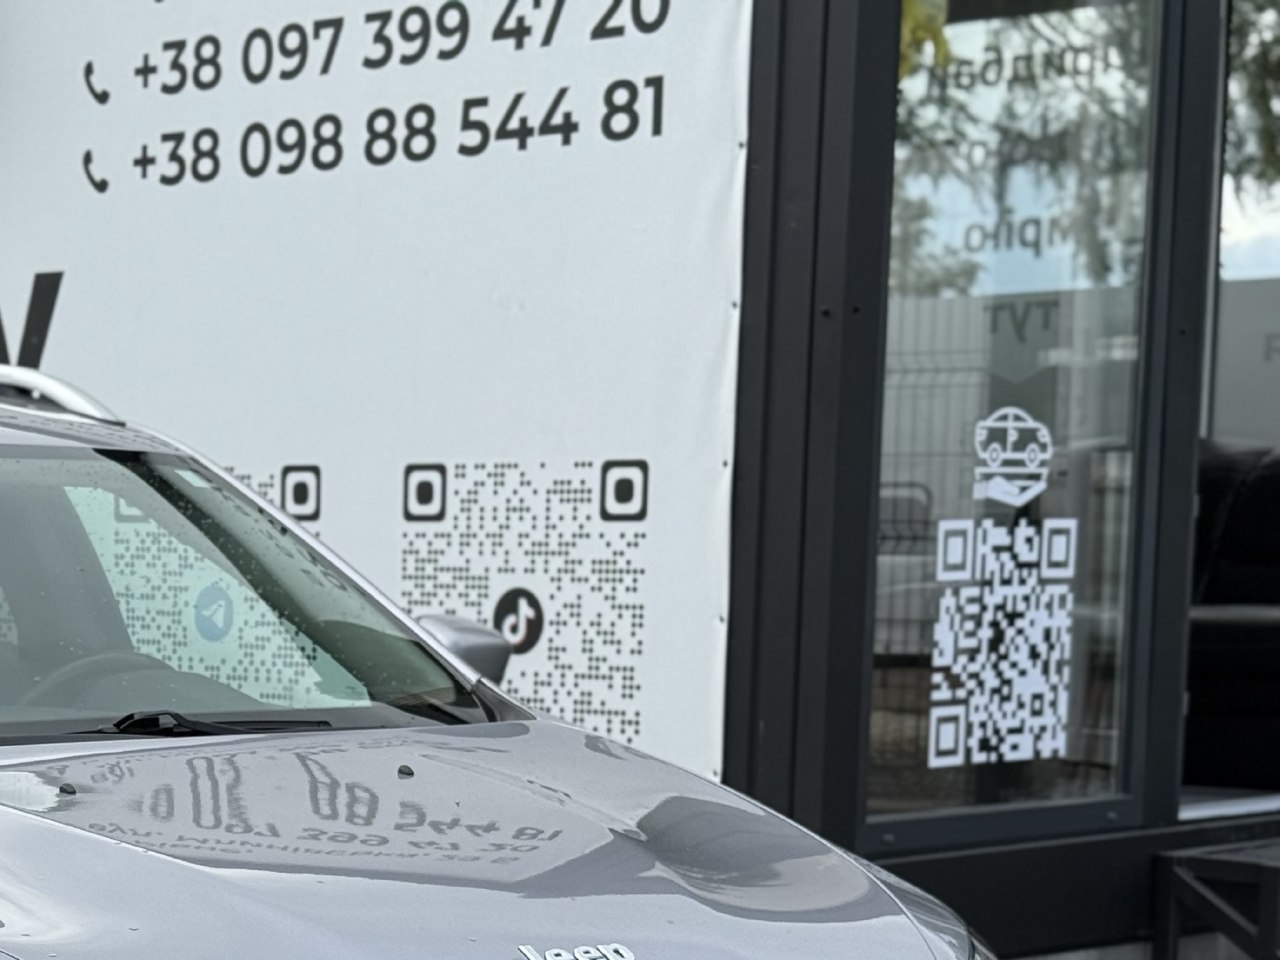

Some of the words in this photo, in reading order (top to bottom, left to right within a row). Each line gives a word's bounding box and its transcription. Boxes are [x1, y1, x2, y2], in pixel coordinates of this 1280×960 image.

[133, 34, 222, 95] +38
[242, 17, 344, 85] 097
[362, 0, 470, 70] 399
[492, 0, 568, 51] 47
[590, 0, 671, 41] 20
[132, 127, 221, 186] +38
[239, 113, 344, 178] 098
[364, 103, 437, 166] 88
[457, 87, 579, 157] 544
[600, 75, 664, 142] 81
